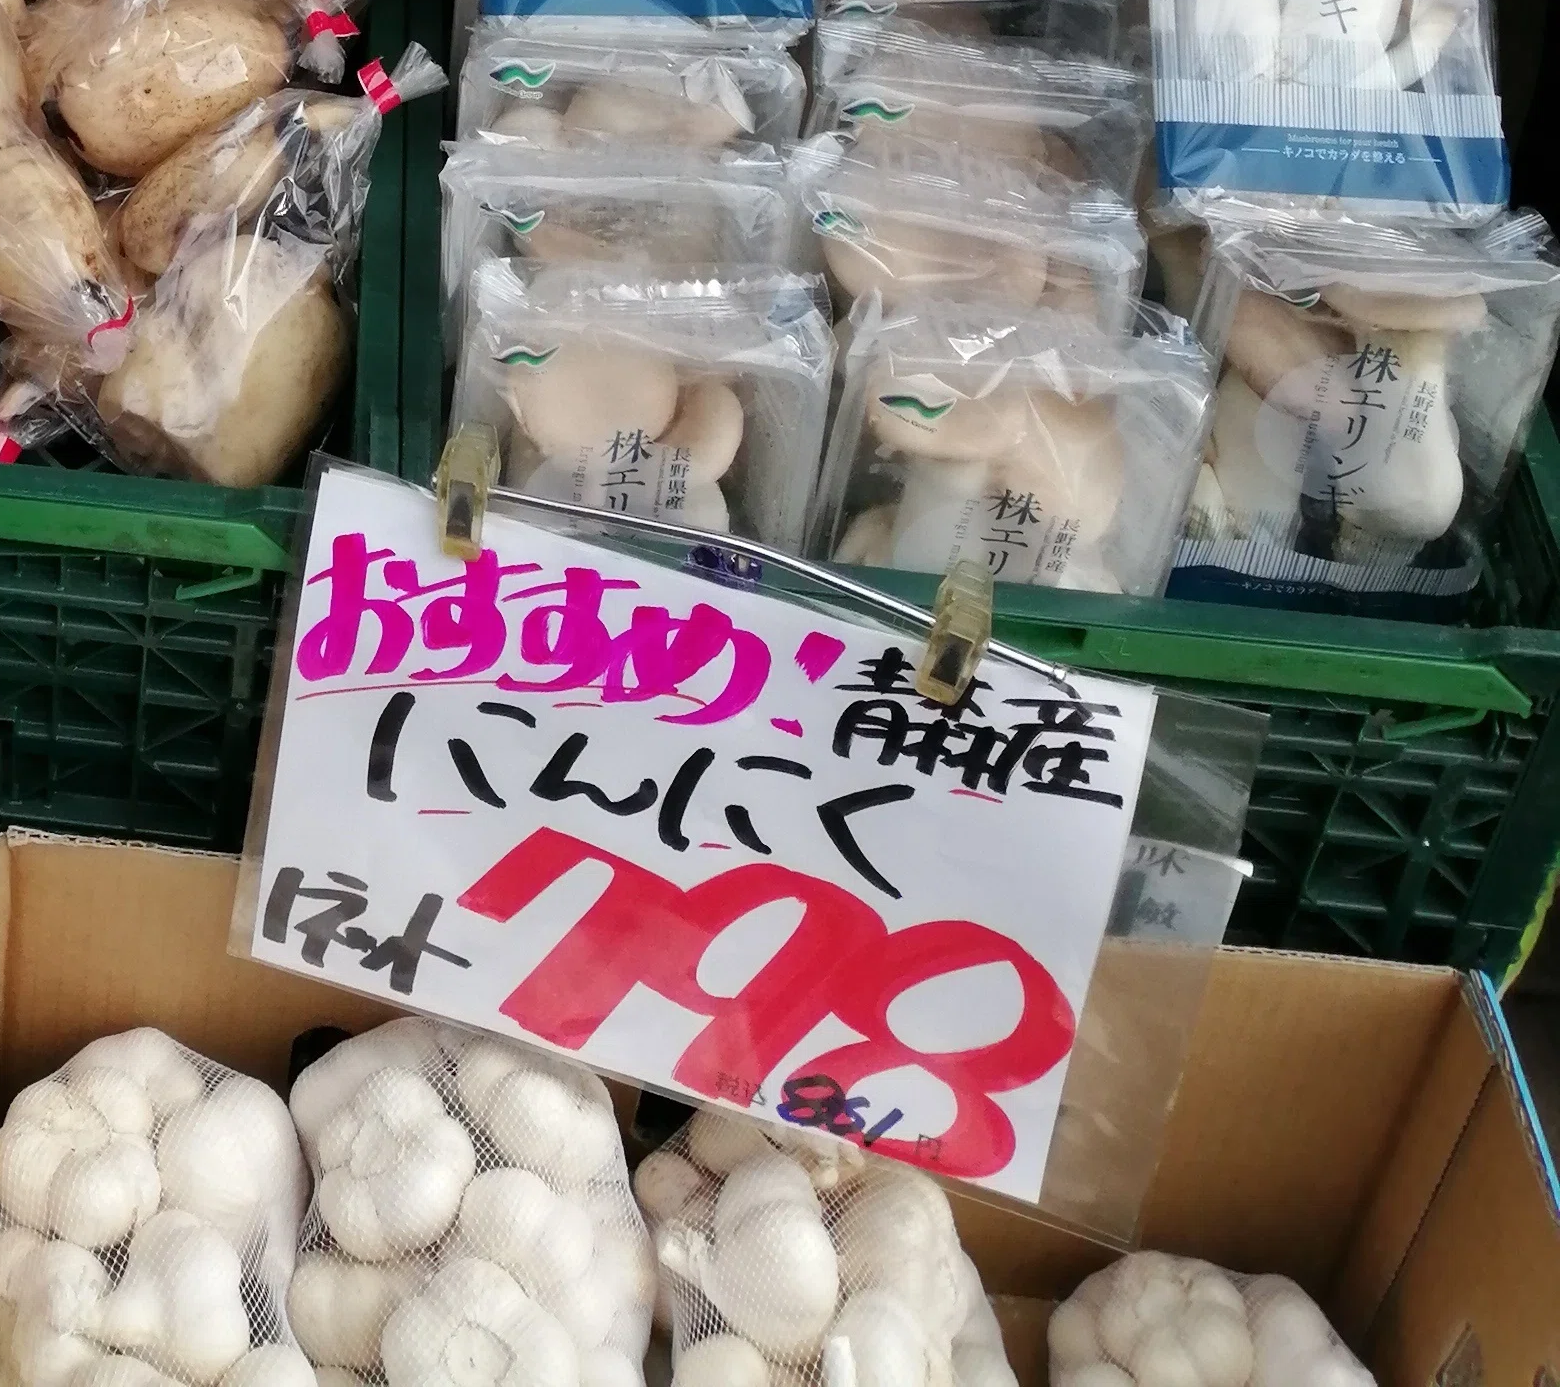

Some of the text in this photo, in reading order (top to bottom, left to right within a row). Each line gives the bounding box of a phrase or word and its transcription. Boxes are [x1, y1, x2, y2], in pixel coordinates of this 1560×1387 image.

[665, 446, 693, 513] 長野県産
[1316, 342, 1402, 519] 株エリンギ
[365, 691, 916, 901] にんにく
[458, 825, 1078, 1180] 798
